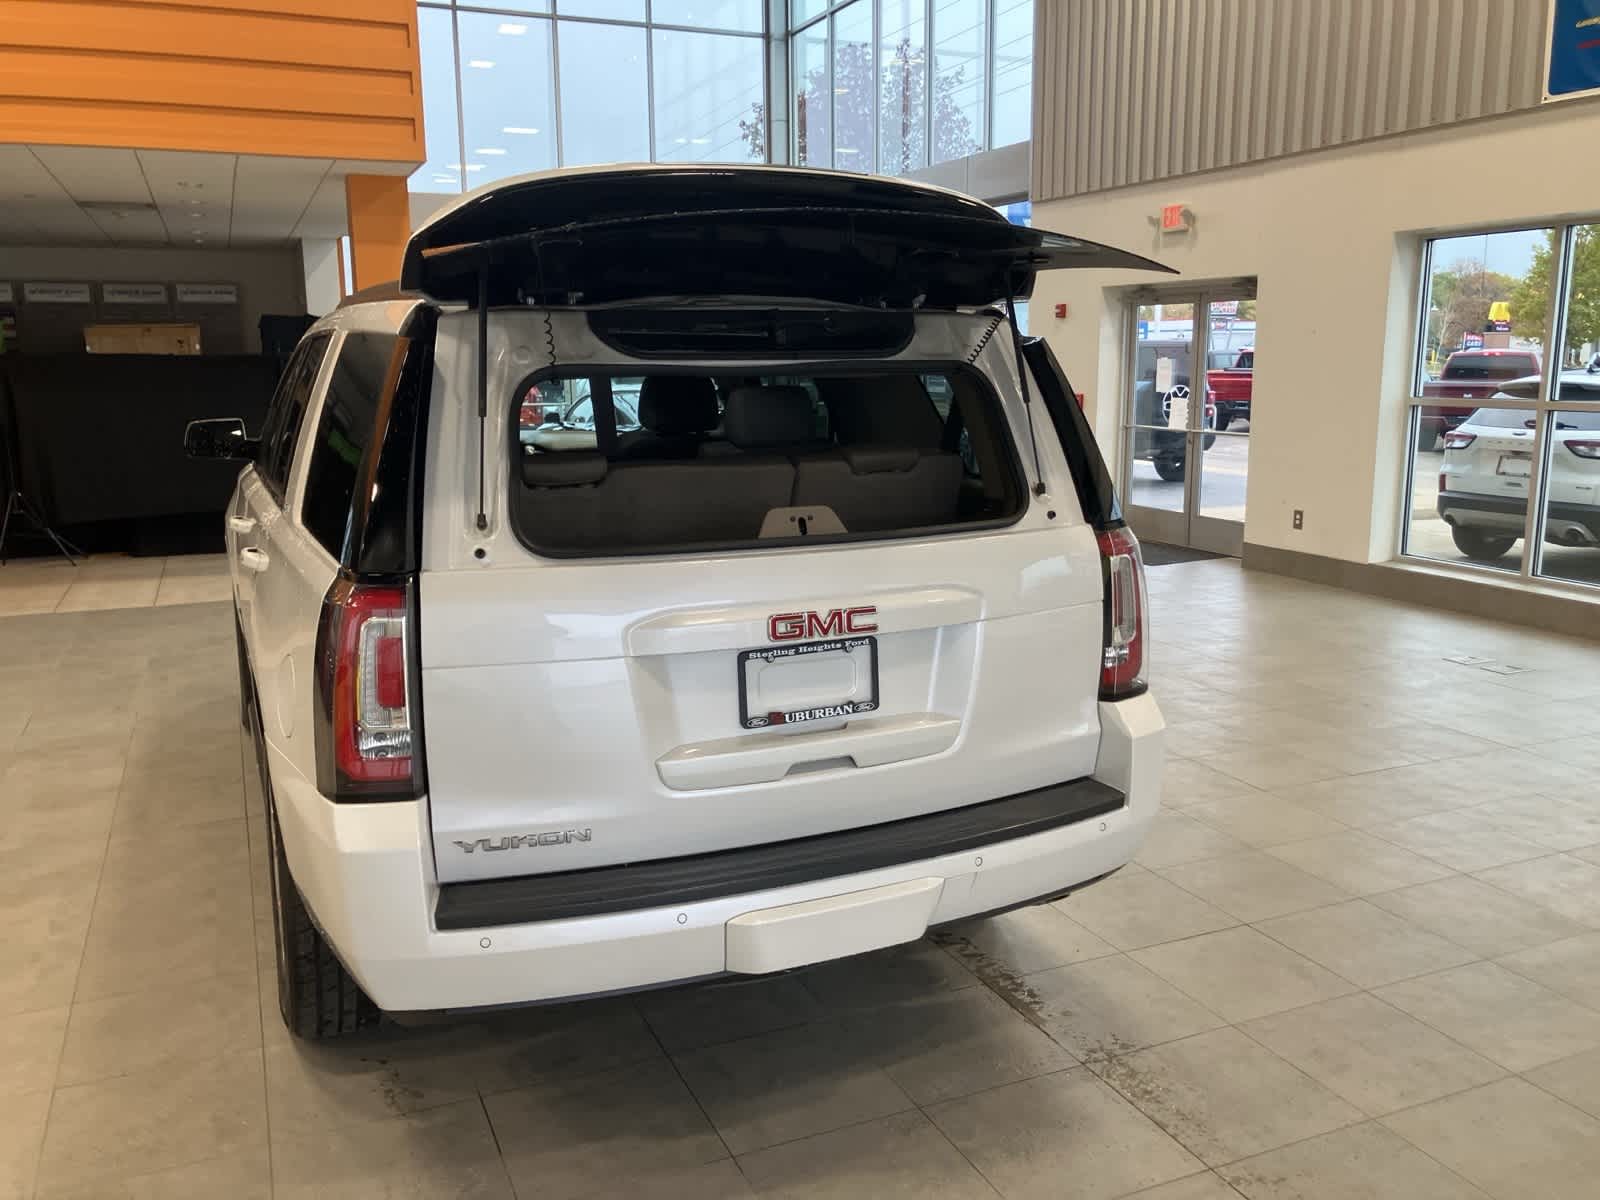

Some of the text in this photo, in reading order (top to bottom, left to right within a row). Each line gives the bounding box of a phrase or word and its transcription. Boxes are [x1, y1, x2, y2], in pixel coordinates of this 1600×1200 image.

[768, 606, 878, 641] GMC
[748, 638, 870, 659] Sterling Heights Ford
[768, 704, 854, 725] UBURBAN
[452, 827, 592, 854] YUKON
